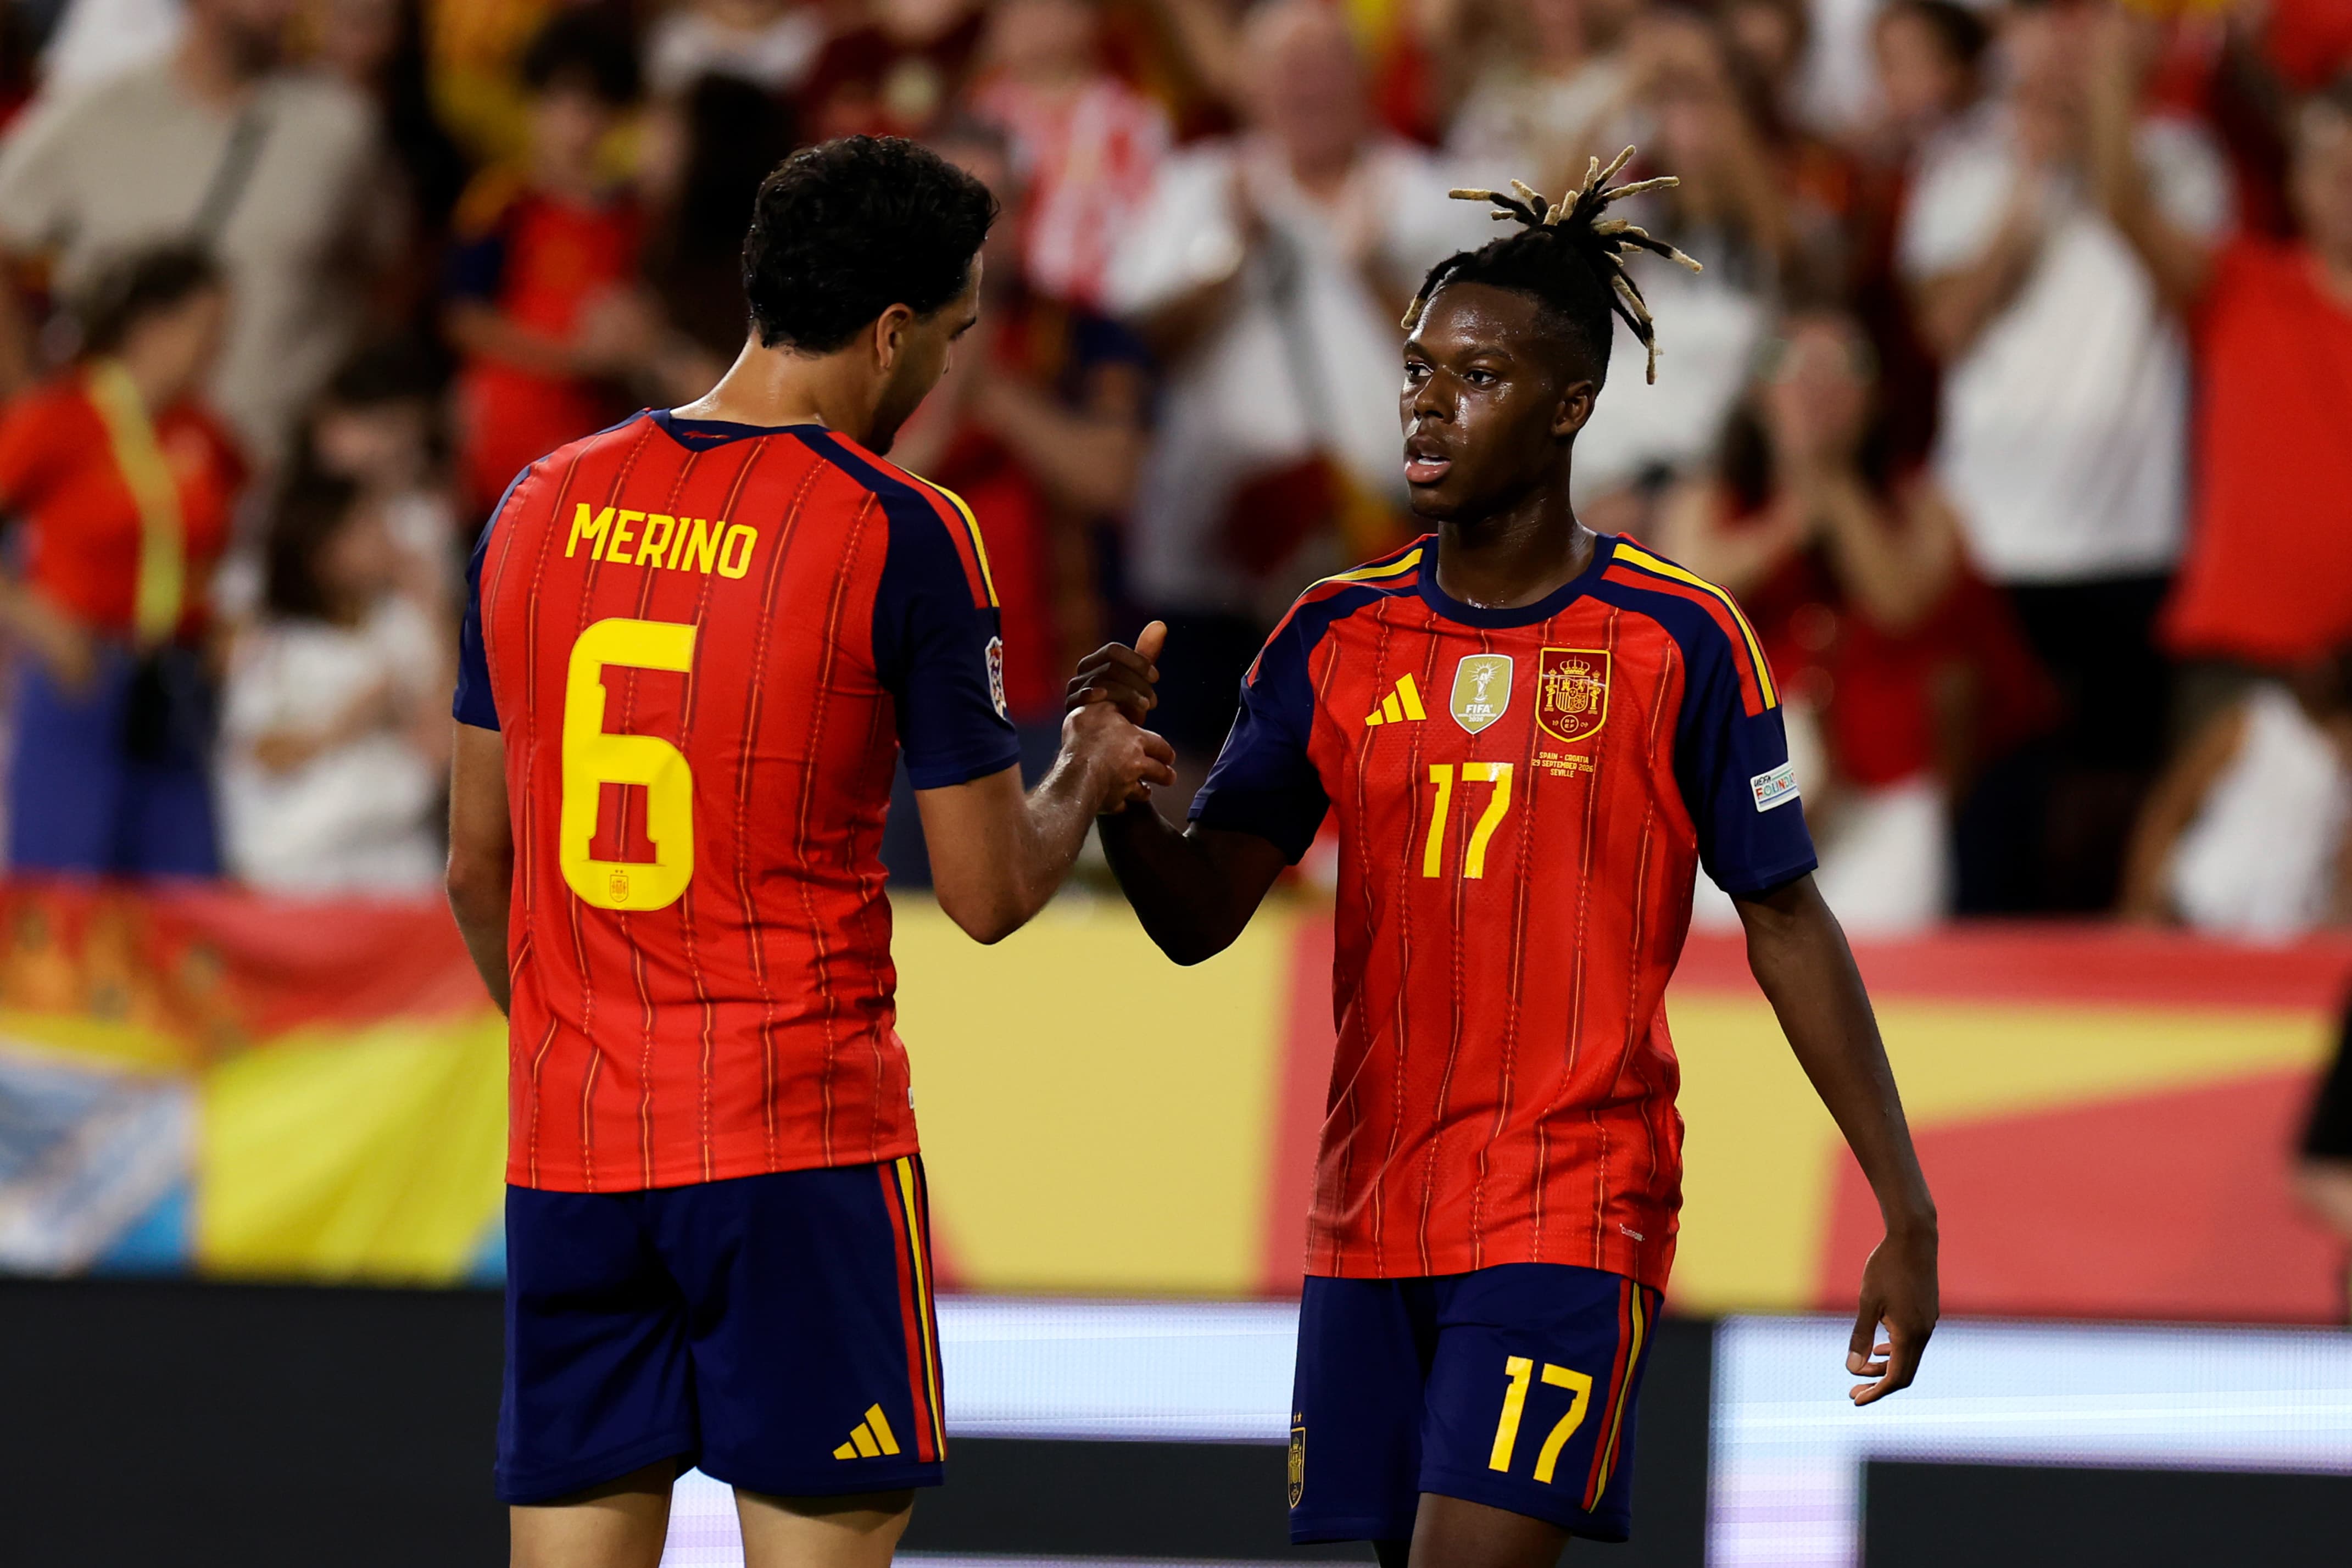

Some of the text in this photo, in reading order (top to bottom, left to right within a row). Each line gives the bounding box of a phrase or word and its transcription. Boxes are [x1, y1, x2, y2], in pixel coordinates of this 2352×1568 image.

[565, 503, 757, 579] MERINO
[1465, 704, 1491, 713] FIFA
[560, 617, 698, 912] 6
[1539, 751, 1558, 760] SPAIN
[1564, 754, 1589, 764] CROATIA
[1532, 758, 1593, 773] 29 SEPTEMBER 2026
[1550, 768, 1575, 778] SEVILLE
[1754, 774, 1771, 787] UEFA
[1423, 762, 1514, 879] 17
[1489, 1355, 1592, 1484] 17
